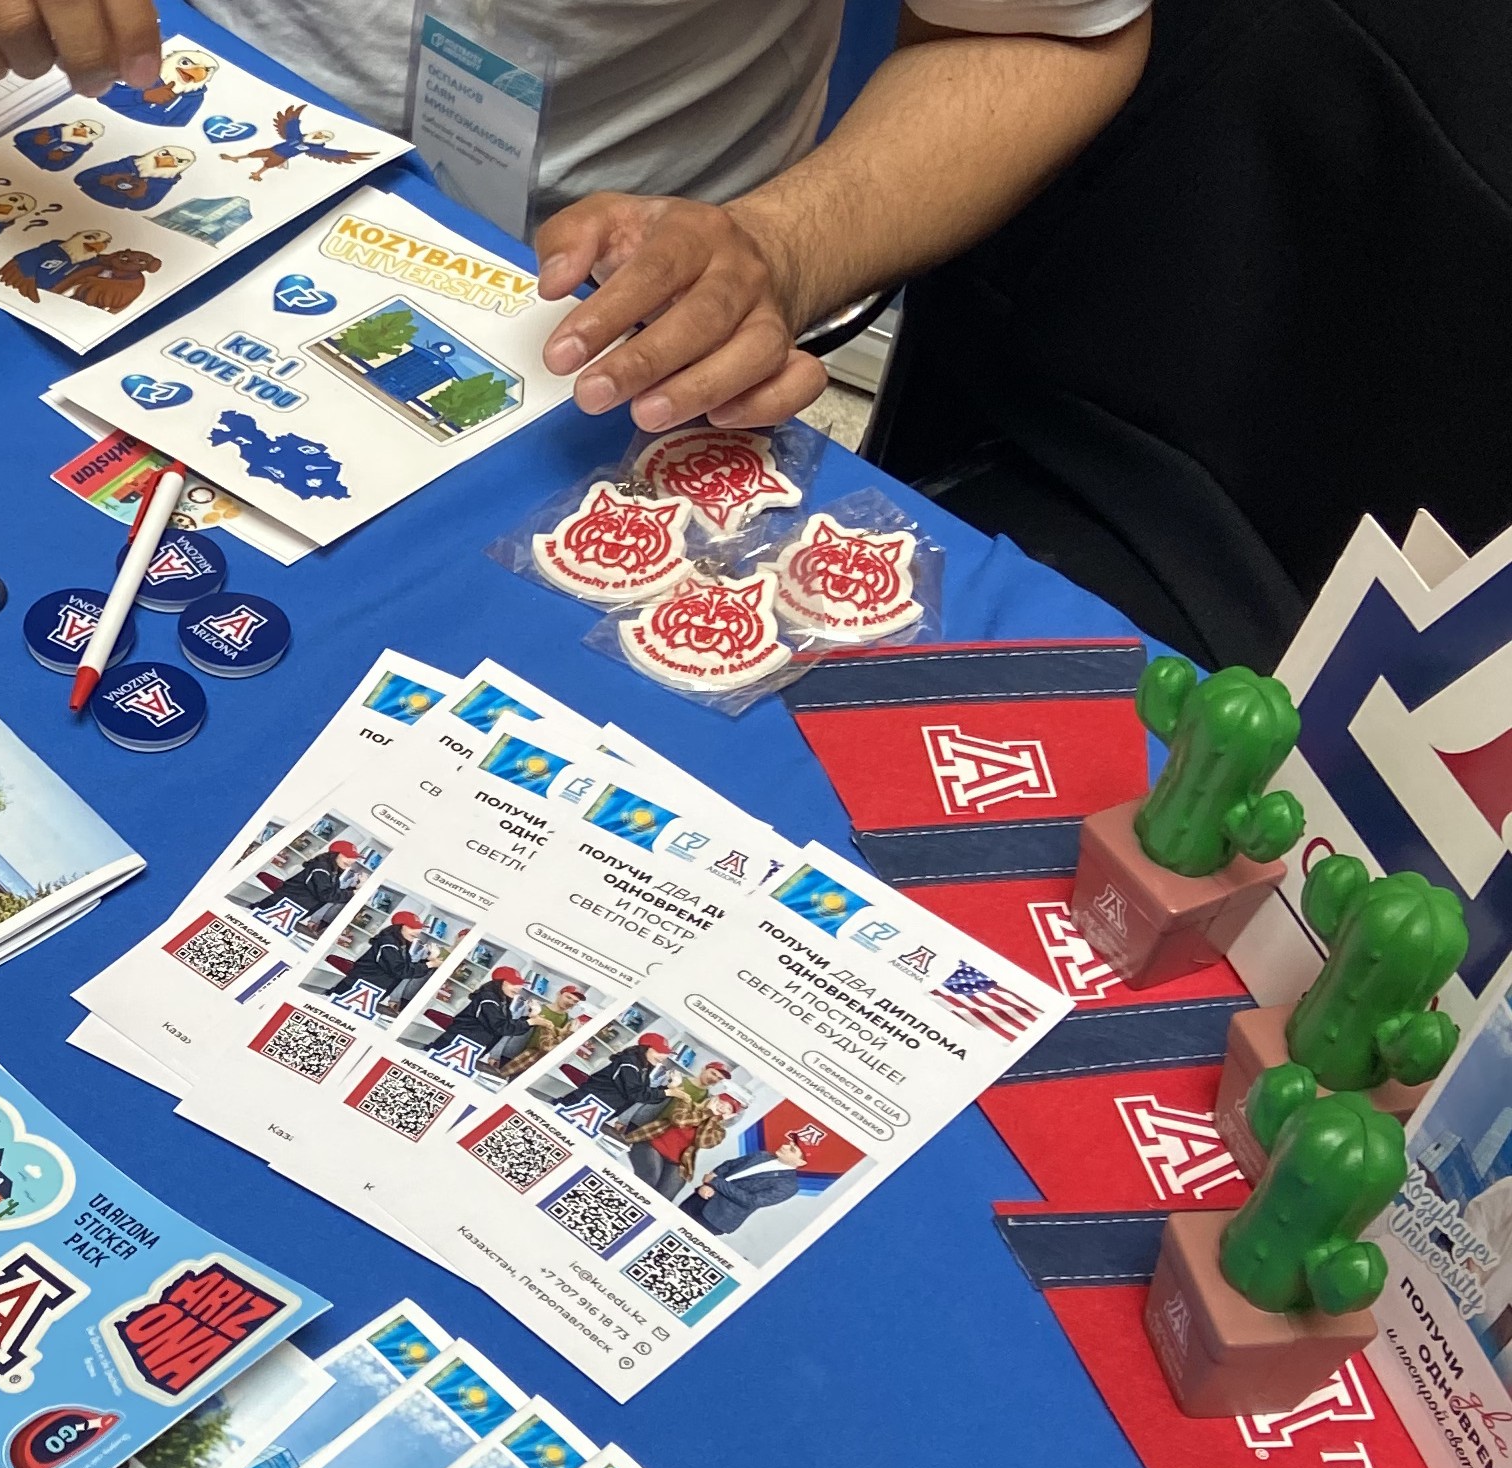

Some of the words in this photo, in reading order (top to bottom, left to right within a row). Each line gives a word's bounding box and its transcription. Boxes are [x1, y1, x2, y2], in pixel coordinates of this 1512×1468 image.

[324, 235, 533, 315] UNIVERSITY
[337, 217, 535, 295] KOZYBAYEV
[169, 340, 236, 381] LOVE
[245, 374, 302, 410] YOU
[276, 359, 297, 377] I
[176, 534, 217, 574] ARIZONA
[544, 541, 562, 562] The
[552, 556, 611, 589] University
[630, 557, 682, 587] Arizona
[610, 578, 627, 588] of
[187, 623, 239, 661] ARIZONA
[633, 627, 646, 646] The
[727, 643, 780, 673] Arizona
[638, 642, 707, 677] University
[710, 666, 725, 676] of
[102, 669, 158, 701] ARIZONA
[579, 843, 654, 884] ПОЛУЧИ
[654, 881, 701, 907] ДВА
[224, 913, 272, 946] INSTAGRAM
[569, 893, 648, 939] СВЕТЛОЕ
[534, 928, 580, 955] Занятия
[581, 952, 619, 974] только
[888, 958, 924, 984] ARIZONA
[757, 920, 831, 970] ПОЛУЧИ
[829, 969, 877, 998] ДВА
[873, 998, 967, 1060] ДИПЛОМА
[778, 954, 920, 1050] ОДНОВРЕМЕННО
[303, 1004, 356, 1033] INSTAGRAM
[736, 970, 814, 1025] СВЕТЛОЕ
[814, 1022, 907, 1086] БУДУЩЕЕ!
[785, 980, 801, 994] И
[800, 991, 888, 1052] ПОСТРОЙ
[693, 999, 736, 1032] Занятия
[736, 1031, 771, 1056] только
[772, 1055, 787, 1069] на
[787, 1066, 852, 1112] английском
[850, 1110, 885, 1135] языке
[819, 1061, 865, 1095] семестр
[873, 1098, 902, 1120] США
[525, 1109, 575, 1148] INSTAGRAM
[602, 1168, 652, 1206] WHATSAPP
[64, 1232, 112, 1267] PACK
[74, 1213, 137, 1261] STICKER
[678, 1227, 736, 1270] ПОДРОБНЕЕ
[1392, 1209, 1484, 1316] University
[168, 1270, 279, 1334] ARIZ
[457, 1225, 519, 1278] Казахстан,
[518, 1274, 614, 1353] Петропавловск
[539, 1265, 557, 1282] +7
[554, 1278, 579, 1298] 707
[577, 1297, 600, 1315] 916
[598, 1313, 613, 1327] 18
[610, 1324, 631, 1341] 73
[568, 1261, 648, 1326] ic@ku.edu.kz
[126, 1306, 234, 1389] ONA
[1400, 1277, 1465, 1381] ПОЛУЧИ
[46, 1426, 79, 1454] GO
